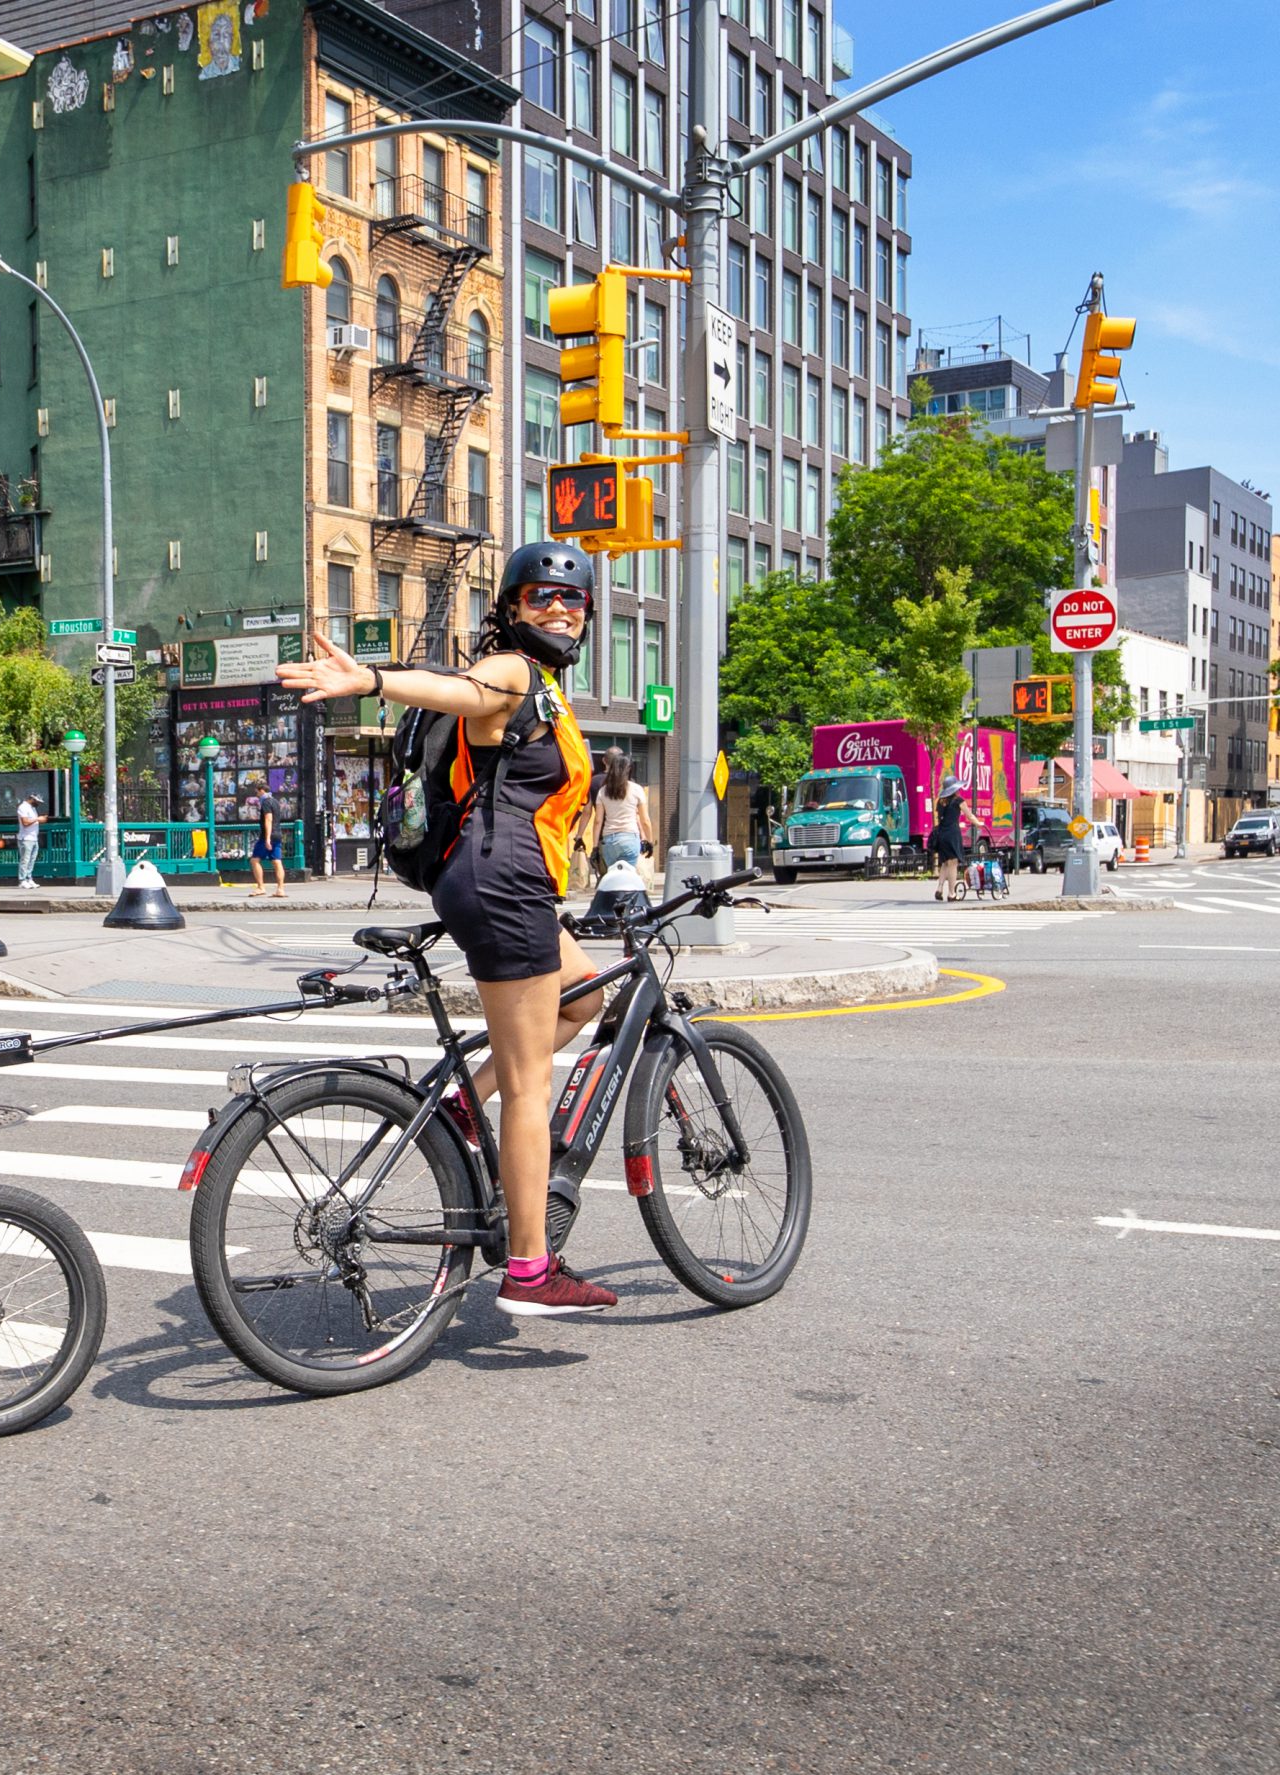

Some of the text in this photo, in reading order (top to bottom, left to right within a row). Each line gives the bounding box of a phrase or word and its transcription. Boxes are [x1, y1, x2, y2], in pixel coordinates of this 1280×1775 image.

[711, 315, 733, 347] KEEP
[711, 396, 734, 431] RIGHT
[594, 477, 616, 520] 12
[1063, 601, 1105, 613] DO NOT
[51, 623, 57, 633] E
[59, 621, 94, 633] Houston
[118, 632, 123, 643] 2
[1066, 628, 1103, 640] ENTER
[117, 670, 132, 679] WAY
[271, 693, 295, 702] Dusty
[1035, 687, 1047, 709] 12
[183, 698, 260, 711] OUT IN THE STREETS
[277, 702, 300, 712] Rebel
[653, 694, 672, 722] TD
[1170, 721, 1179, 729] St
[123, 831, 151, 844] Subway
[585, 1064, 623, 1152] RALEIGH
